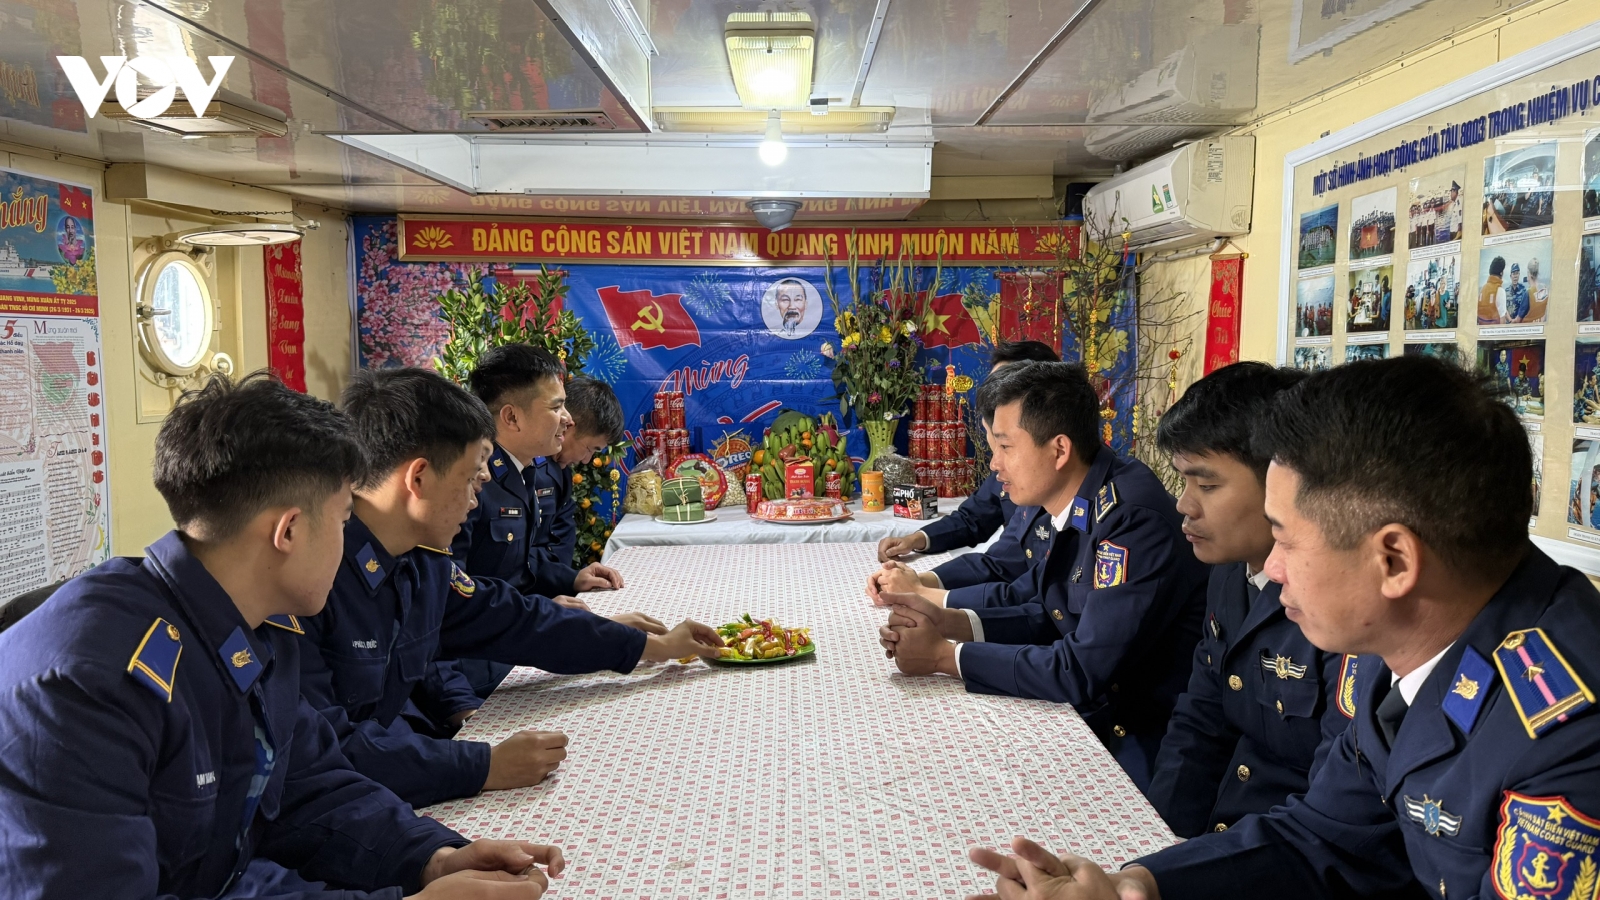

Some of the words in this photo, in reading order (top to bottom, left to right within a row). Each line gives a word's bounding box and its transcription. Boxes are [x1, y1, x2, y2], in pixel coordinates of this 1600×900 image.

[1394, 140, 1420, 173] ĐỘNG
[1420, 125, 1439, 161] CỦA
[1440, 122, 1459, 154] TÀU
[1460, 115, 1486, 148] 8003
[1488, 102, 1526, 139] TRONG
[1527, 85, 1568, 125] NHIỆM
[1571, 79, 1590, 116] VỤ
[472, 223, 534, 253] ĐẢNG
[541, 225, 601, 256] CỘNG
[607, 225, 652, 254] SẢN
[658, 228, 703, 258] VIỆT
[710, 231, 758, 255] NAM
[766, 232, 838, 257] QUANG
[845, 232, 894, 255] VINH
[901, 229, 963, 255] MUÔN
[971, 228, 1020, 255] NĂM
[1540, 830, 1565, 845] COAST
